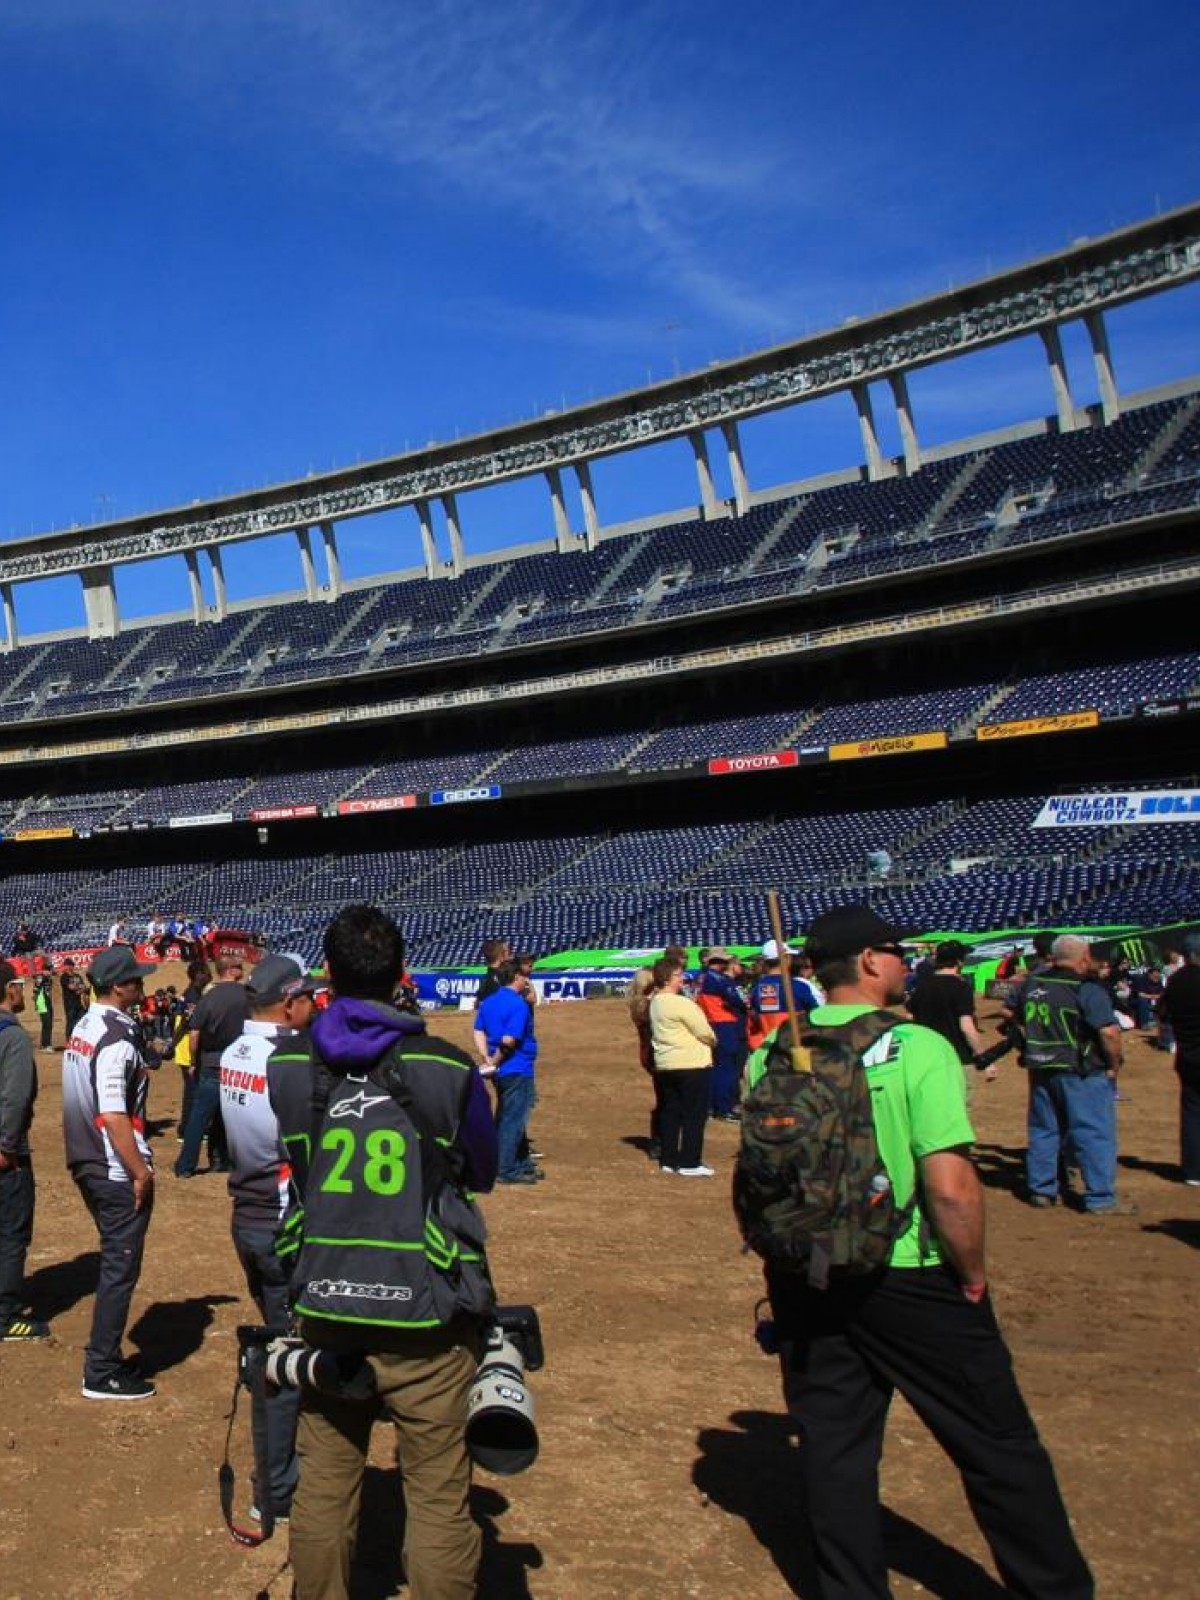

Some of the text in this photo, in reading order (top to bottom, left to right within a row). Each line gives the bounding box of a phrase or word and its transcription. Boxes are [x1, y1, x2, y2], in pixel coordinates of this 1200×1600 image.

[728, 755, 780, 770] TOYOTA
[1050, 796, 1129, 812] NUCLEAR
[1056, 808, 1137, 824] COWBOYZ
[320, 1127, 406, 1196] 28
[307, 1279, 413, 1301] alpinestars
